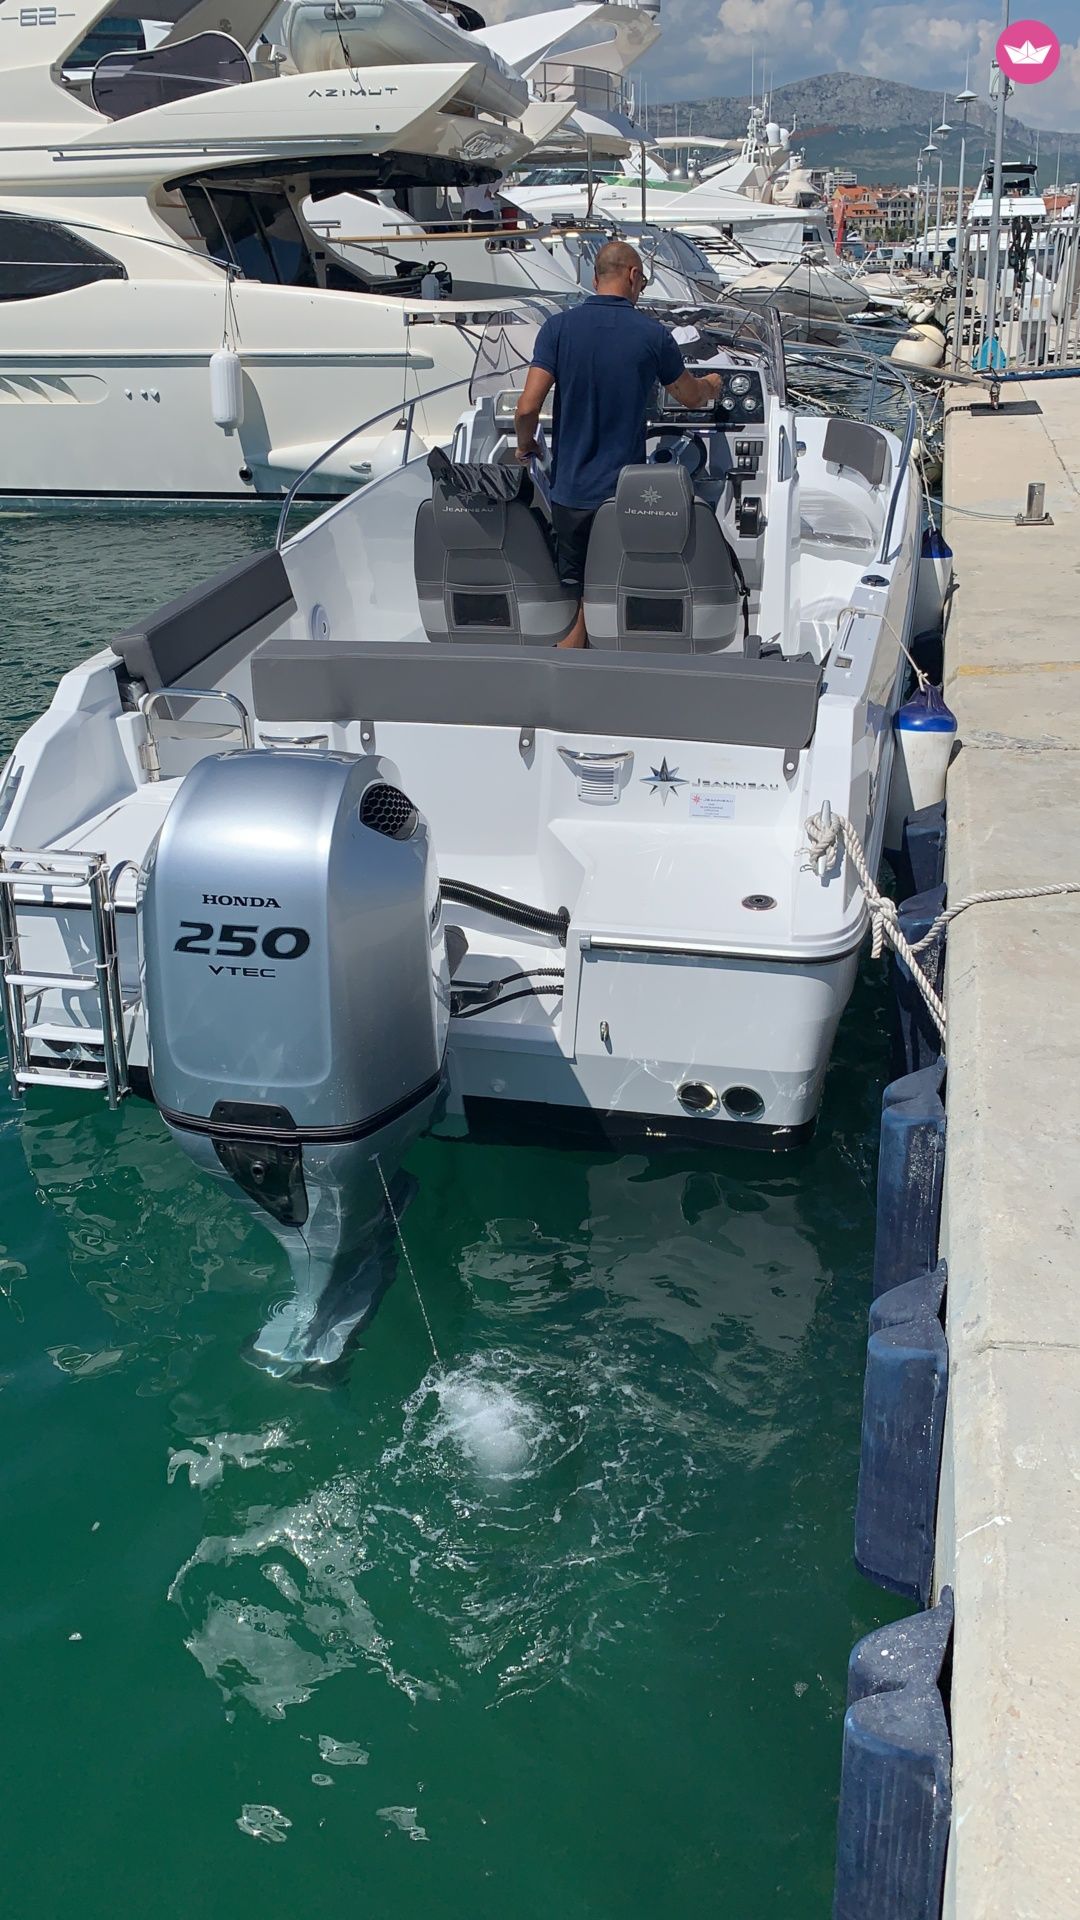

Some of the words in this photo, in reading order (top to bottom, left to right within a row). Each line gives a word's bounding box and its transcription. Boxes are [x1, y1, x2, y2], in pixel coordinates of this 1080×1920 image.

[308, 86, 398, 98] AZIMUT
[624, 507, 679, 517] JEANNEAU
[691, 777, 779, 791] JEANNEAU
[202, 893, 282, 909] HONDA
[173, 919, 311, 960] 250
[208, 964, 276, 978] VTEC
